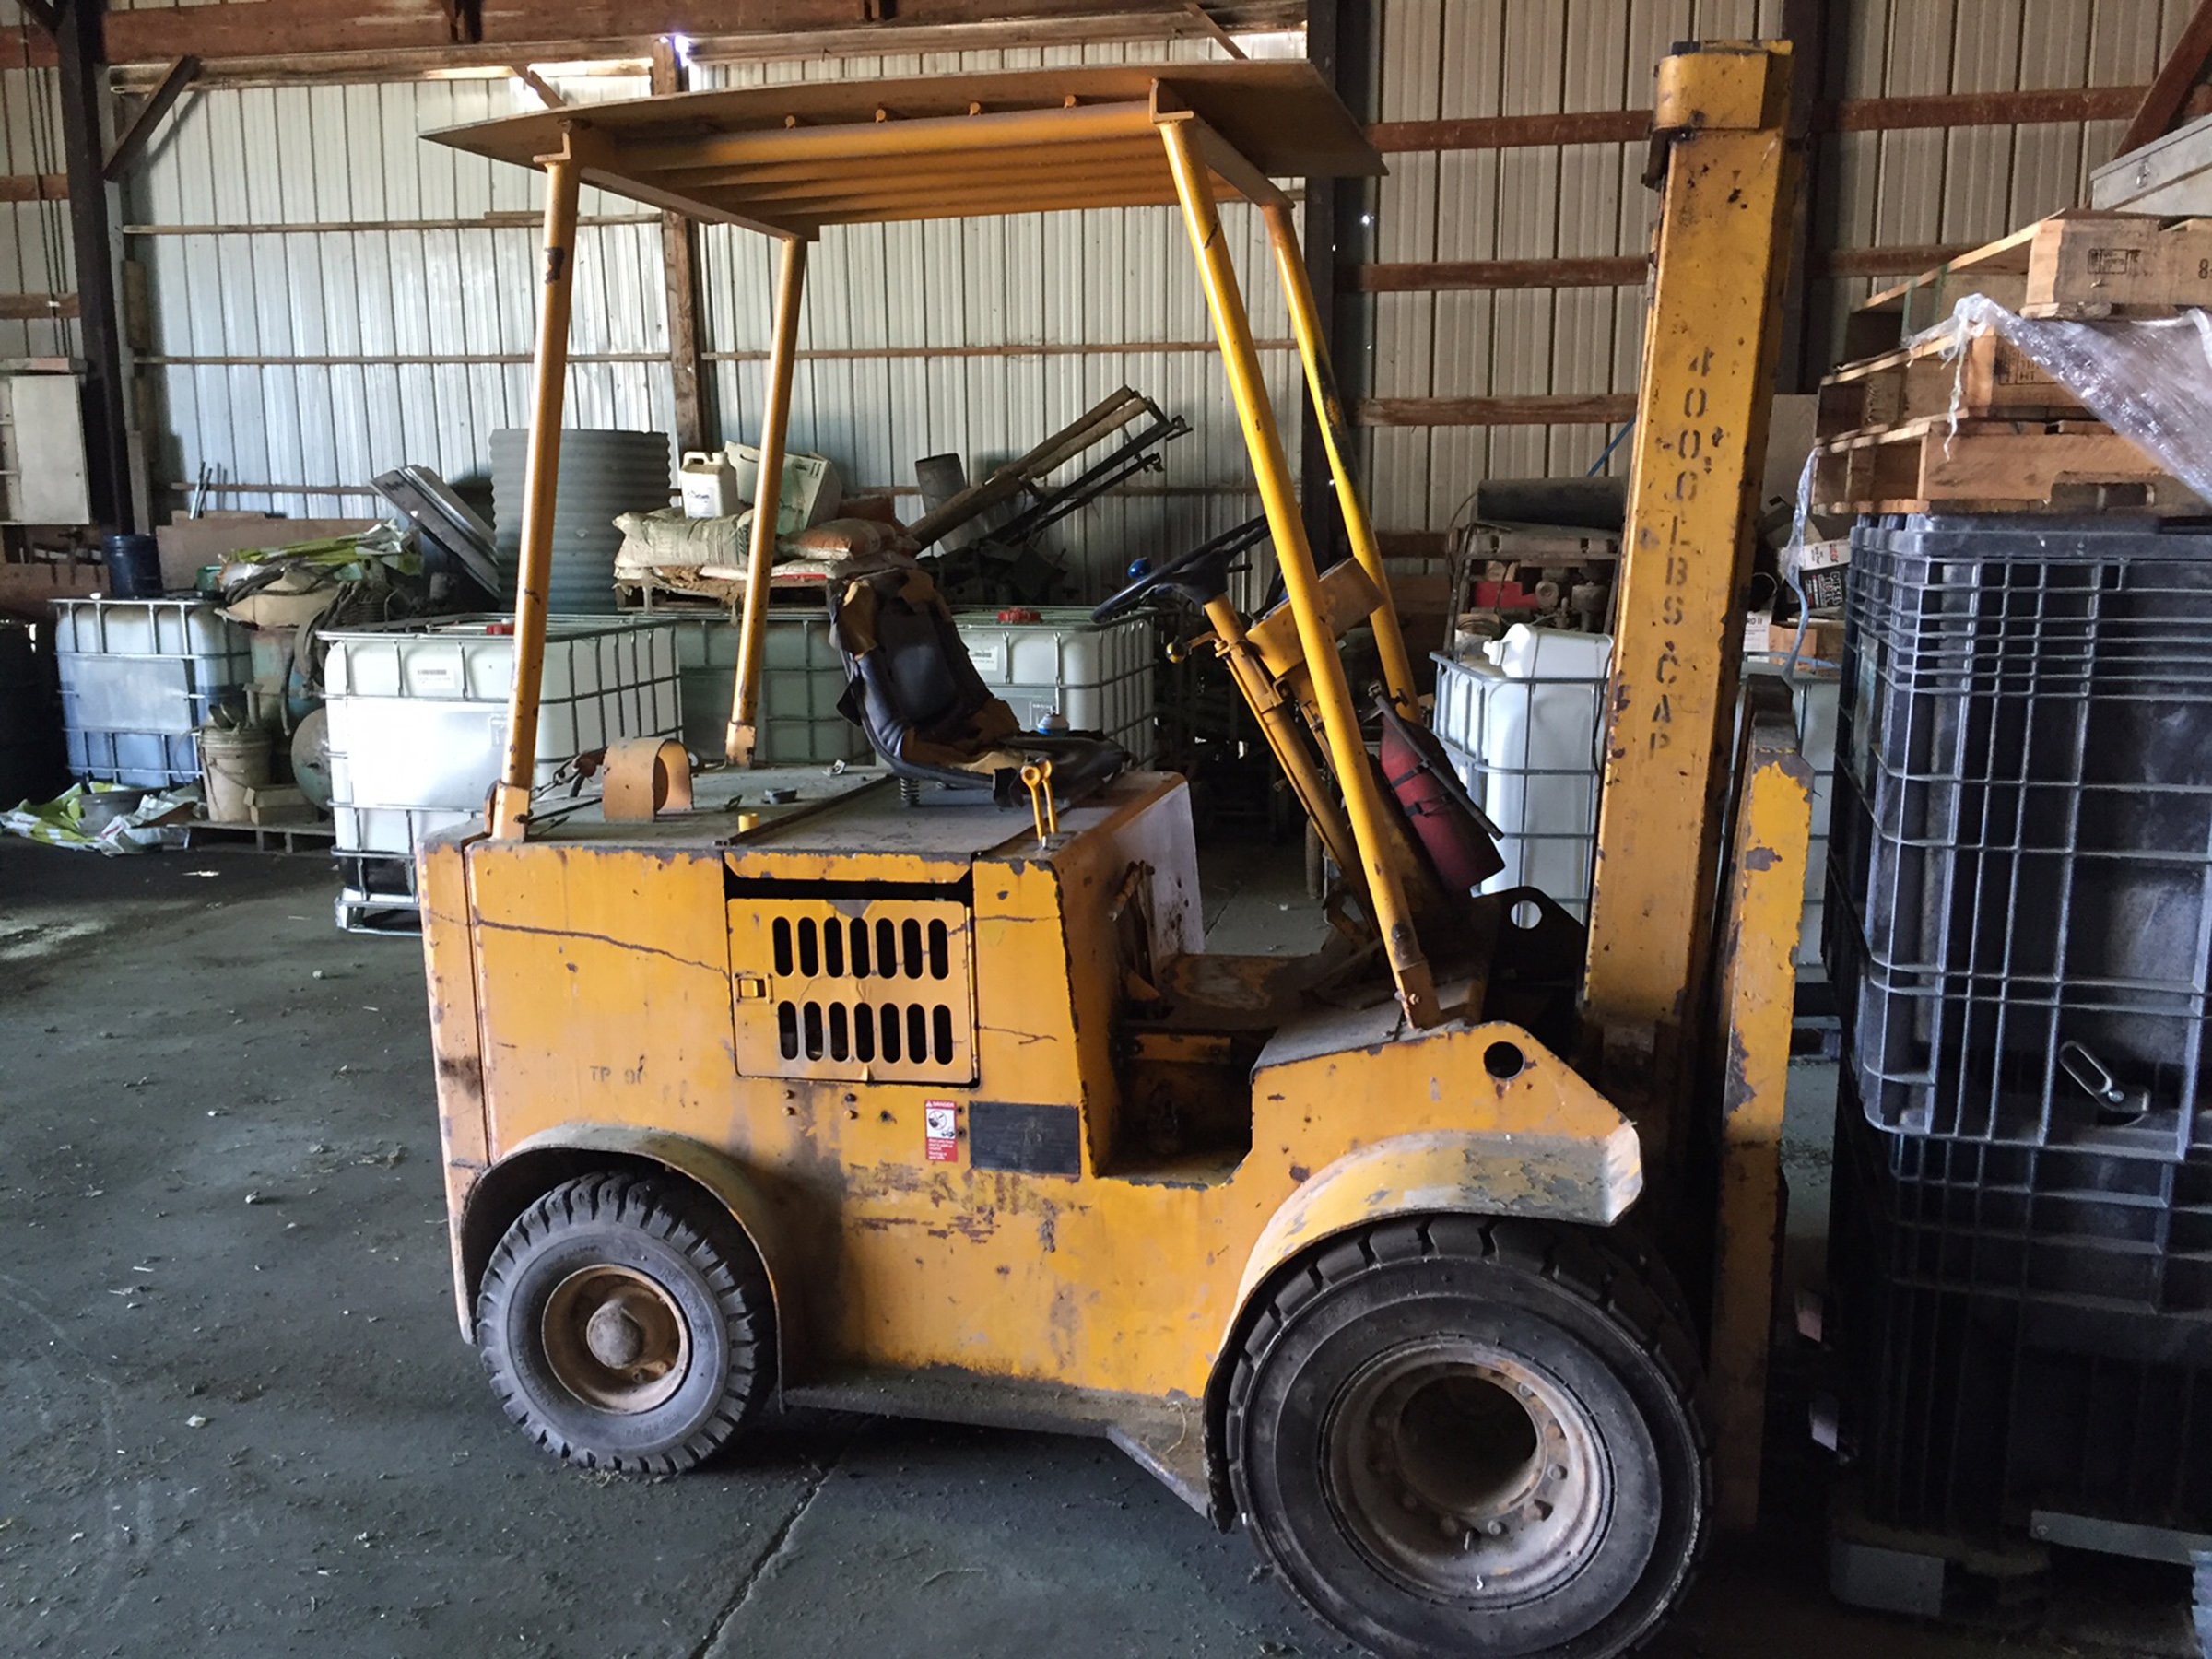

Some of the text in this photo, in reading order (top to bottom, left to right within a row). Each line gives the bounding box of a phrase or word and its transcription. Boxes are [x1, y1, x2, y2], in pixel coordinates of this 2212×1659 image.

[1676, 347, 1714, 501] 4000
[1829, 571, 1843, 606] DIESEL
[589, 1065, 612, 1082] TP
